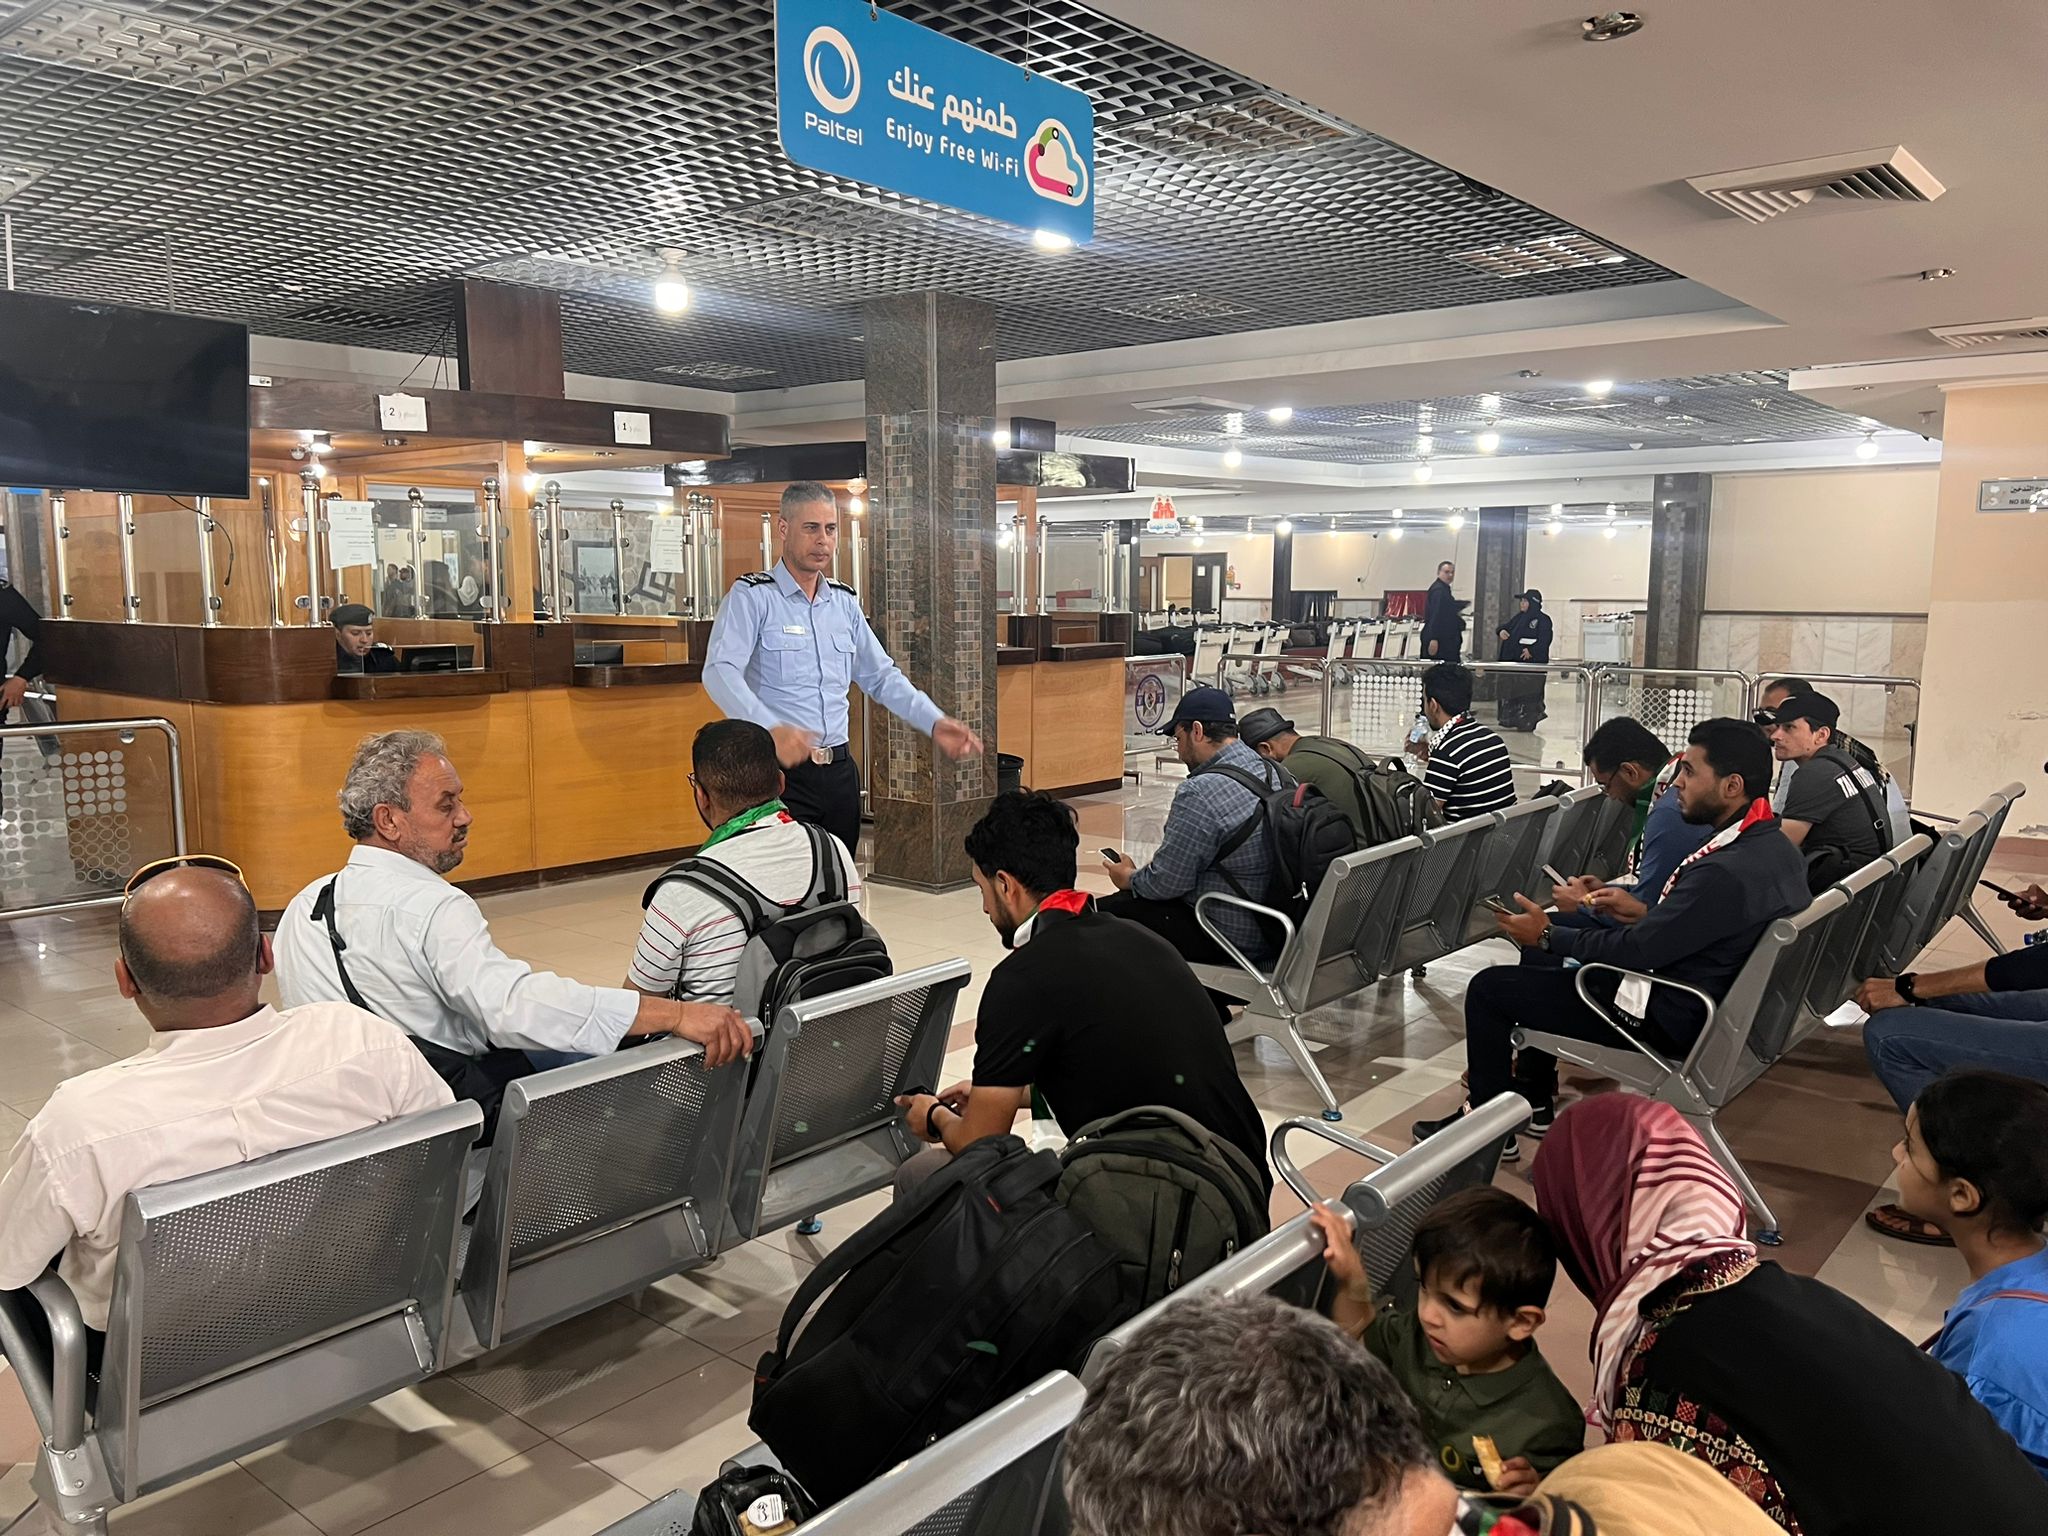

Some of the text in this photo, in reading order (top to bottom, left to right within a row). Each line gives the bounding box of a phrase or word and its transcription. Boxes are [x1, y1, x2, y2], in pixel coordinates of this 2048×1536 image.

[805, 111, 863, 147] Paltel
[887, 65, 1017, 139] طمنهم عنك
[886, 117, 1019, 178] Enjoy Free Wi-Fi
